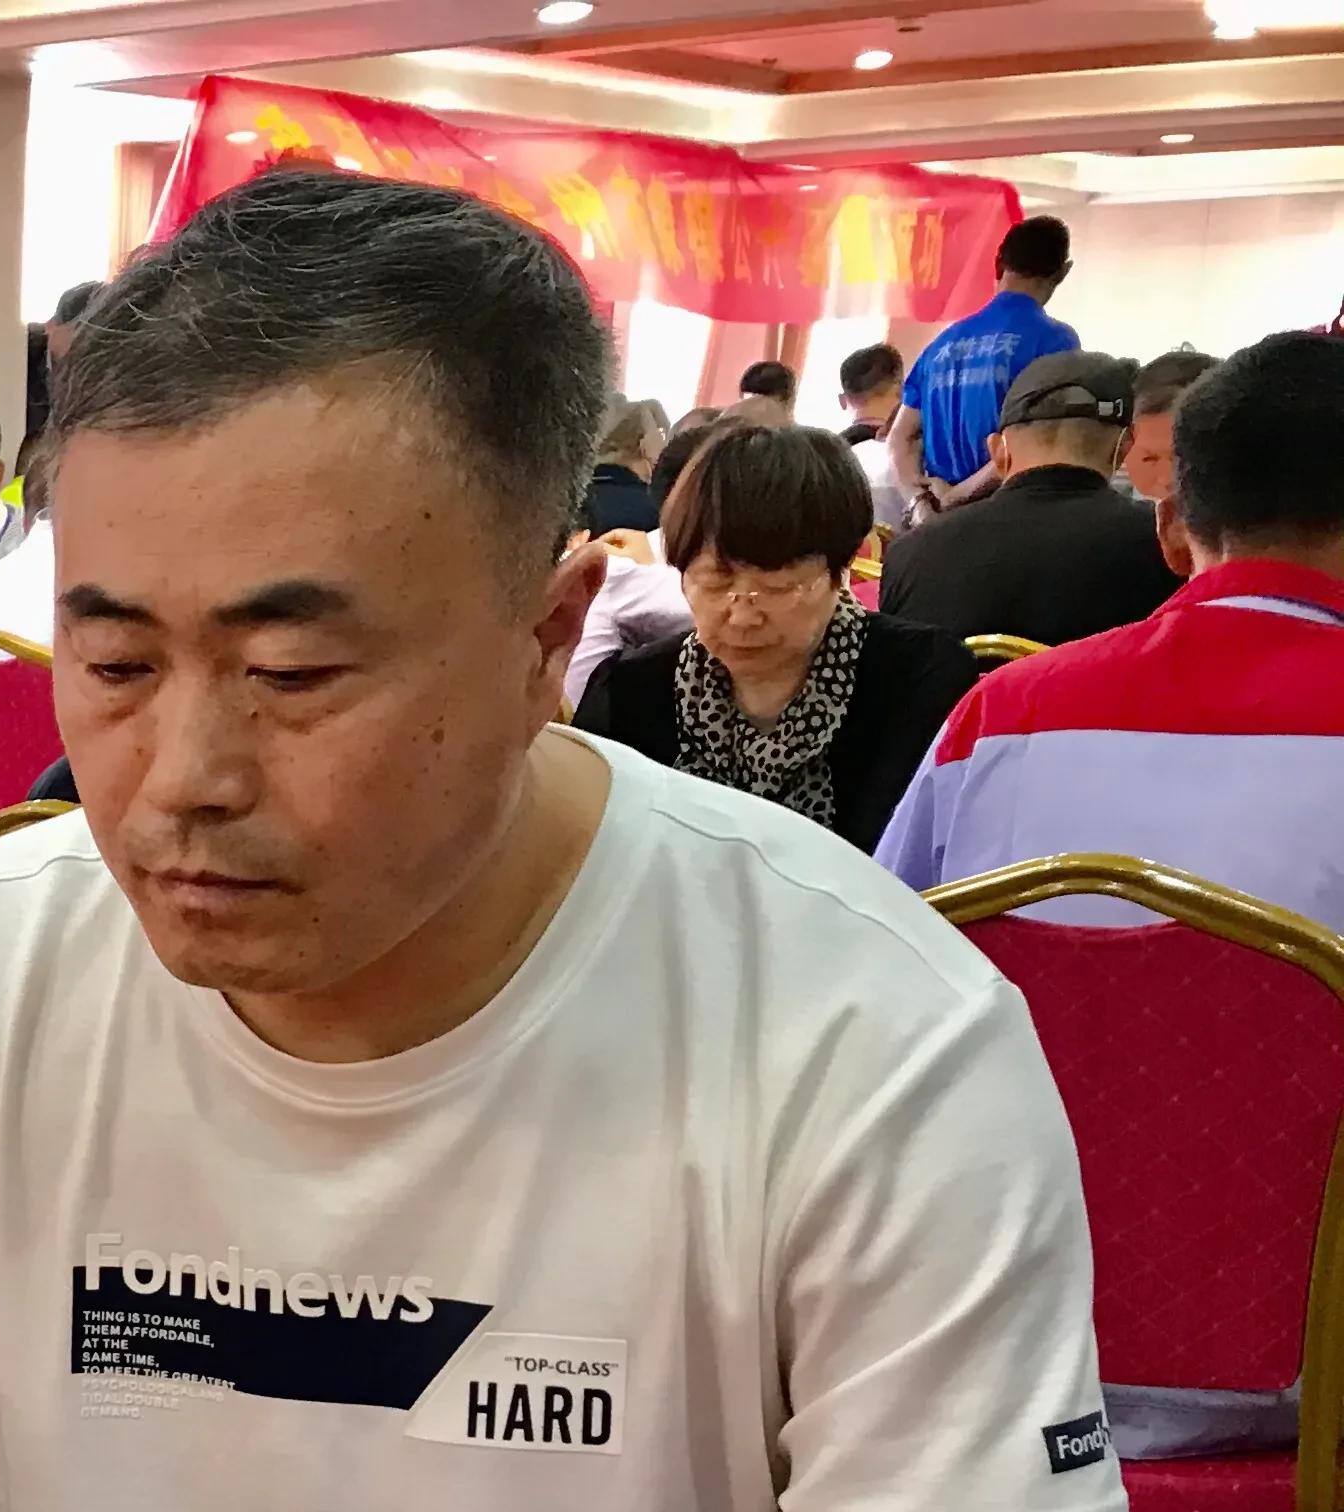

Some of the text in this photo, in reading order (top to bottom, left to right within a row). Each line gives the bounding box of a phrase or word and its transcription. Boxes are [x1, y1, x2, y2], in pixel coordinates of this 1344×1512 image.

[84, 1232, 435, 1323] Fondnews
[82, 1310, 201, 1330] THING IS TO MAKE
[81, 1338, 129, 1350] AT THE
[82, 1324, 215, 1348] THEM AFFORDABLE,
[81, 1351, 160, 1368] SAME TIME,
[82, 1365, 236, 1391] TO MEET THE GREATEST
[467, 1380, 612, 1446] HARD
